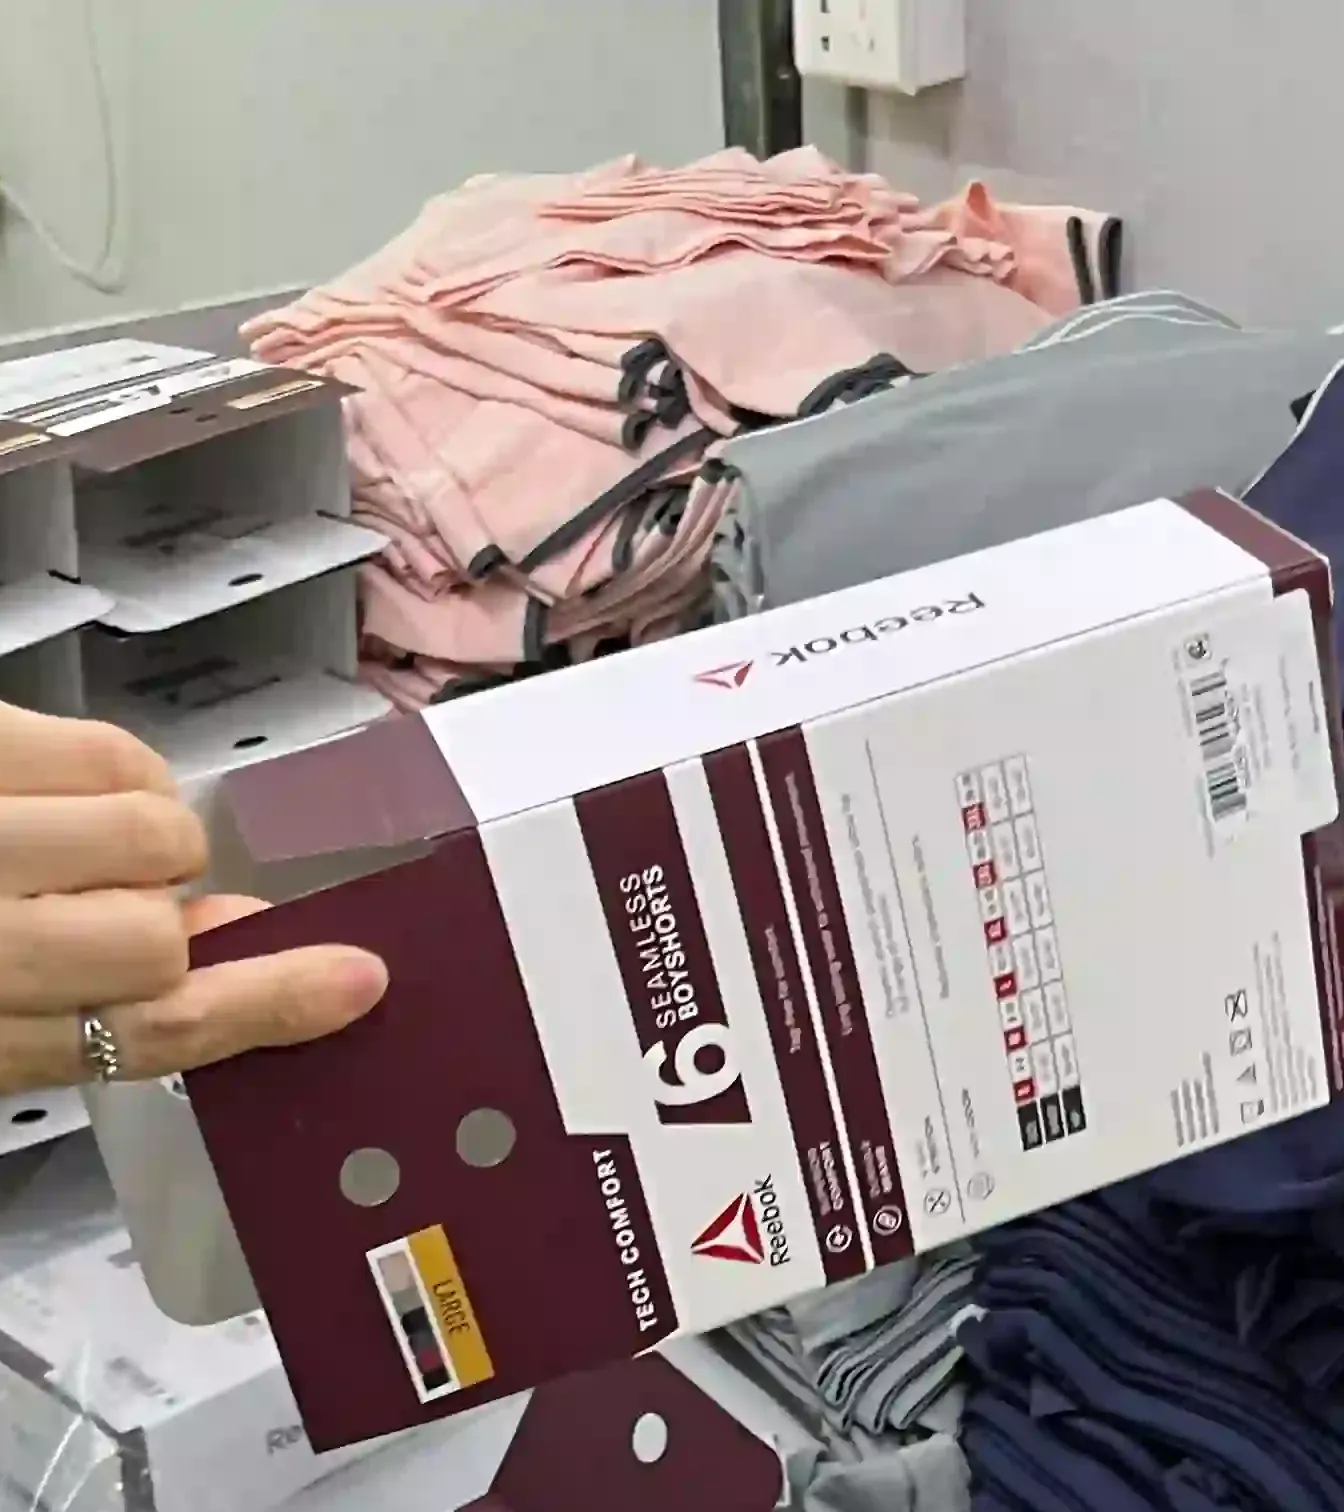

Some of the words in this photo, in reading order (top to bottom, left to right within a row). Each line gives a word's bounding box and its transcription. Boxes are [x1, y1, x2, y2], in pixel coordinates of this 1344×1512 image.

[770, 591, 986, 666] Reebok
[619, 872, 677, 1029] SEAMLESS
[641, 863, 699, 1021] BOYSHORTS
[643, 1022, 743, 1107] 6
[592, 1148, 641, 1266] COMFORT
[753, 1173, 792, 1267] Reebok
[432, 1278, 470, 1335] LARGE
[627, 1268, 658, 1332] TECH
